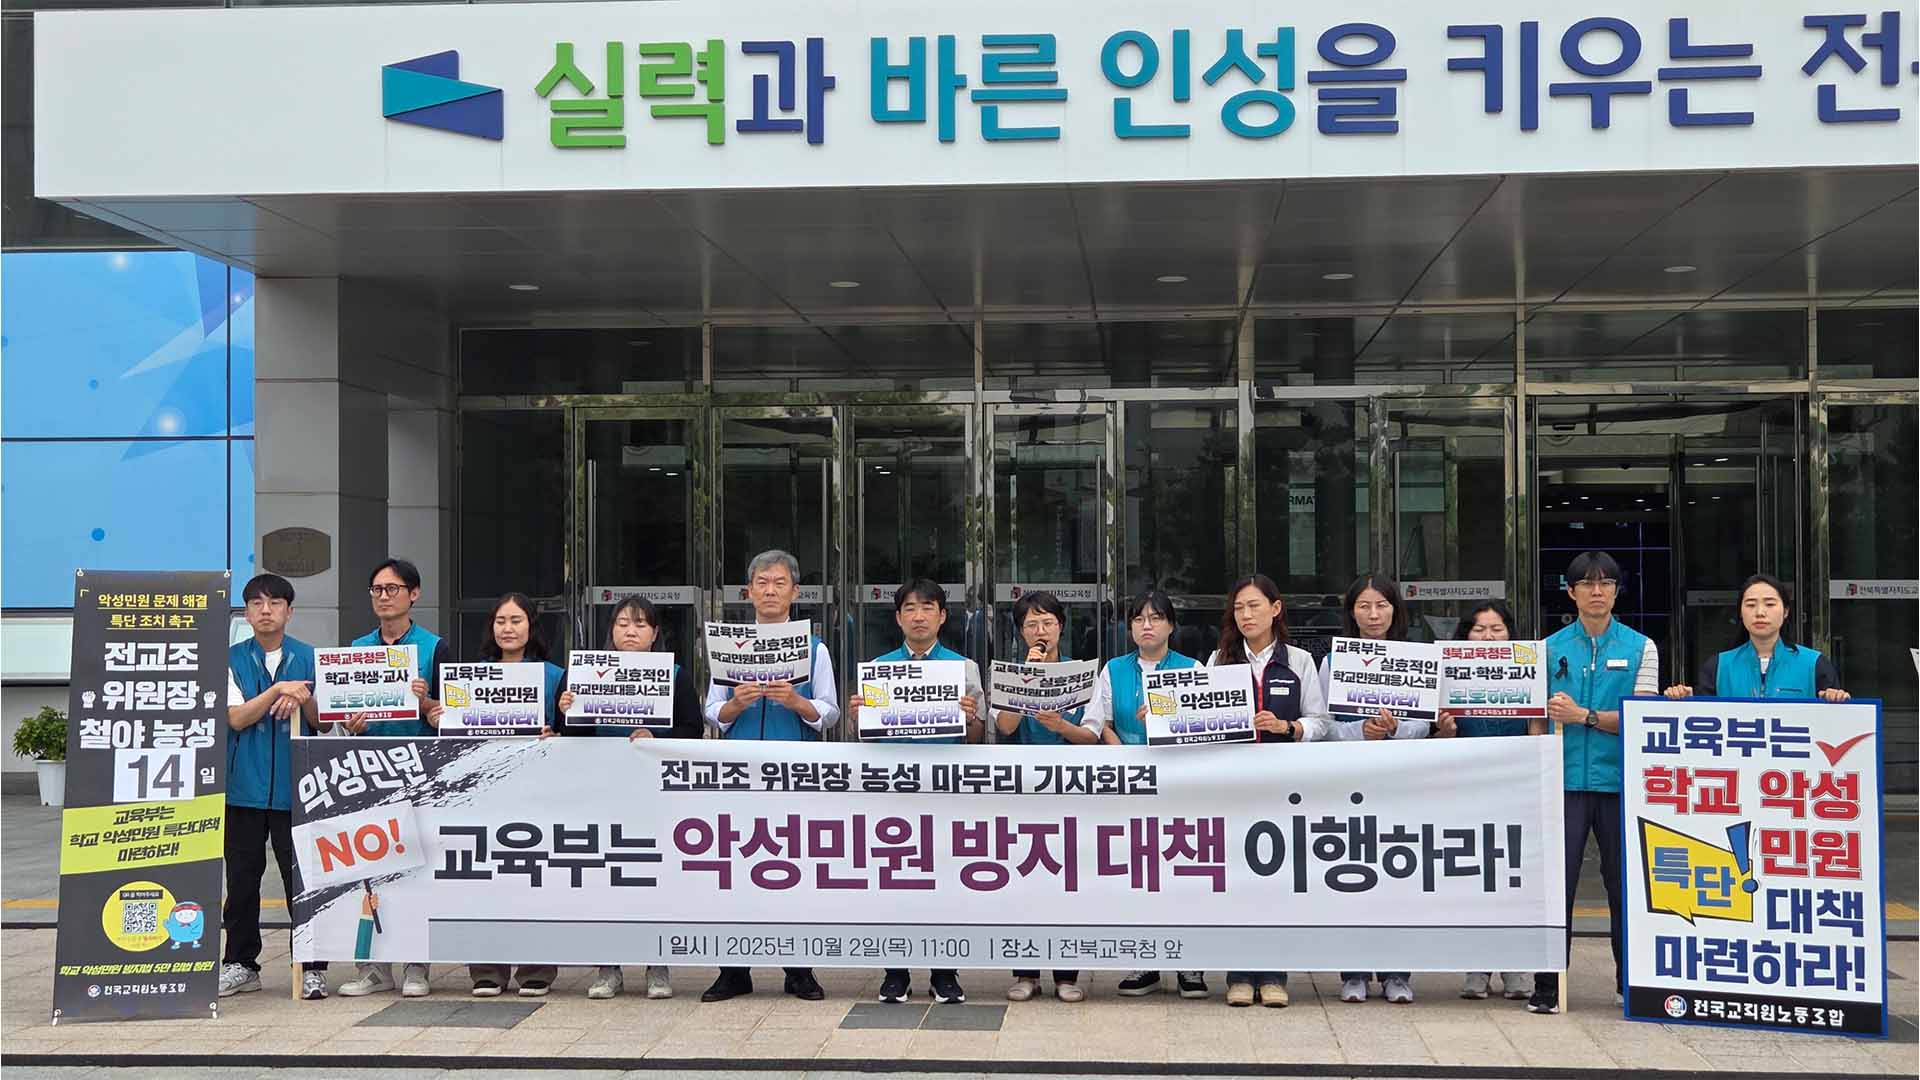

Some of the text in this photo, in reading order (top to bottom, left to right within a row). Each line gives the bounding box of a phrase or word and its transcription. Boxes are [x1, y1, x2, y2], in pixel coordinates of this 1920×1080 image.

[534, 10, 1918, 149] 실력과 바른 인성을 키우는 전
[98, 594, 208, 608] 악성민원 문제 해결
[111, 614, 194, 628] 특단 조치 촉구
[708, 625, 757, 638] 교육부는
[753, 635, 808, 652] 실효적인
[1336, 640, 1386, 656] 교육부는
[104, 642, 198, 672] 전교조
[320, 652, 386, 666] 전북교육청은
[572, 654, 620, 667] 교육부는
[711, 649, 808, 664] 학교민원대응시스템
[444, 666, 503, 681] 교육부는
[614, 668, 670, 682] 실효적인
[862, 664, 922, 680] 교육부는
[994, 663, 1046, 676] 교육부는
[1380, 658, 1438, 675] 실효적인
[1445, 666, 1536, 680] 학교·학생·교사
[325, 669, 408, 685] 학교·학생·교사
[1040, 670, 1094, 687] 실효적인
[1146, 671, 1208, 689] 교육부는
[1333, 670, 1436, 689] 학교민원대응시스템
[102, 681, 200, 710] 위원장
[475, 686, 538, 704] 악성민원
[570, 684, 670, 696] 학교민원대응시스템
[893, 684, 958, 702] 악성민원
[994, 680, 1093, 697] 학교민원대응시스템
[1180, 689, 1248, 710] 악성민원
[80, 719, 216, 750] 철야 농성
[1641, 716, 1810, 758] 교육부는
[128, 754, 216, 800] 14 일
[298, 742, 428, 814] 악성민원
[660, 760, 1158, 796] 전교조 위원장 농성 마무리 기자회견
[1642, 765, 1861, 820] 학교 악성
[113, 806, 175, 825] 교육부는
[70, 818, 220, 848] 학교 악성민원 특단대책
[118, 842, 180, 862] 마련하라!
[316, 817, 406, 874] NO!
[434, 814, 1522, 893] 교육부는 악성민원 방지 대책 이행하라!
[1760, 828, 1862, 880] 민원
[1652, 846, 1736, 907] 특단
[1766, 888, 1864, 938] 대책
[670, 936, 1184, 960] 일시 2025년 10월 2일(목) 11:00 장소 전북교육청 앞
[1655, 936, 1866, 992] 마련하라!
[104, 984, 186, 996] 전국교직원노동조합
[1694, 999, 1844, 1027] 전국교직원노동조합
